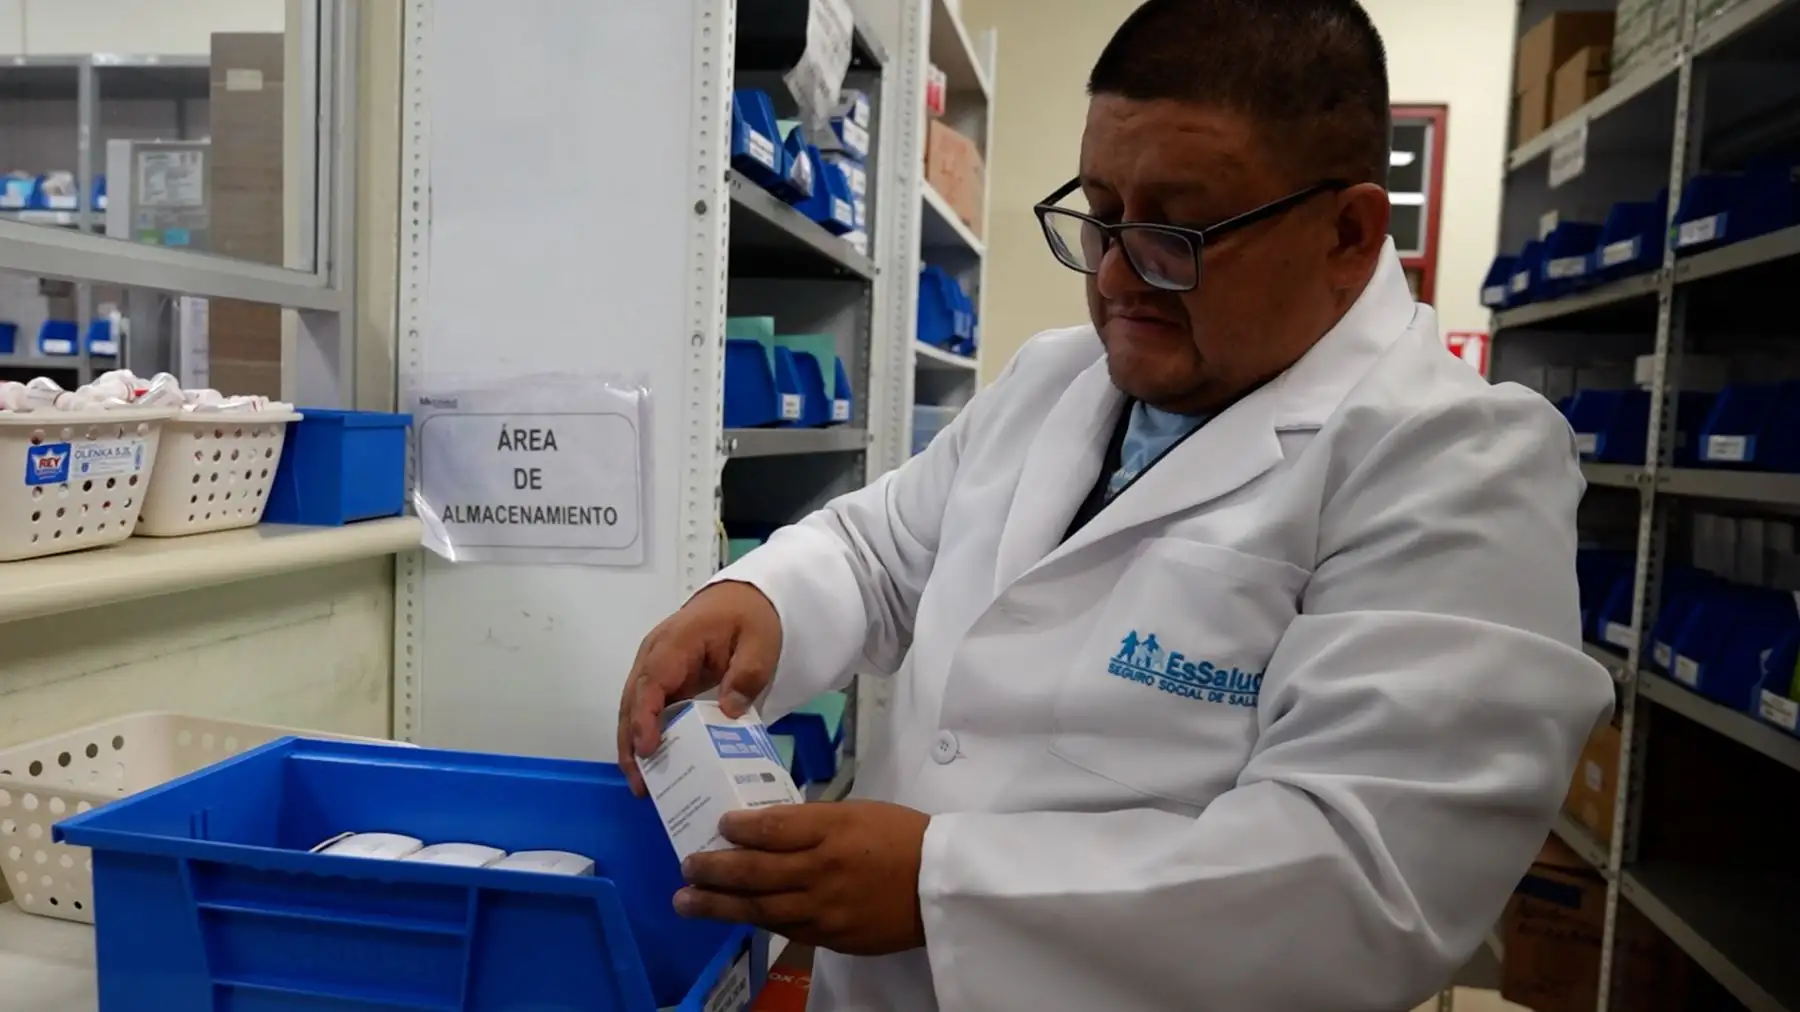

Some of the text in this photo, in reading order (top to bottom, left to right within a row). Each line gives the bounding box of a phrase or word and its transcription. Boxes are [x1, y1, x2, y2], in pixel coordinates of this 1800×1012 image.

[497, 424, 558, 451] ÁREA
[39, 456, 61, 469] REY
[514, 468, 543, 490] DE
[442, 505, 618, 526] ALMACENAMIENTO
[1108, 662, 1155, 686] SEGURO
[1158, 679, 1203, 701] SOCIAL
[1208, 691, 1224, 703] DE
